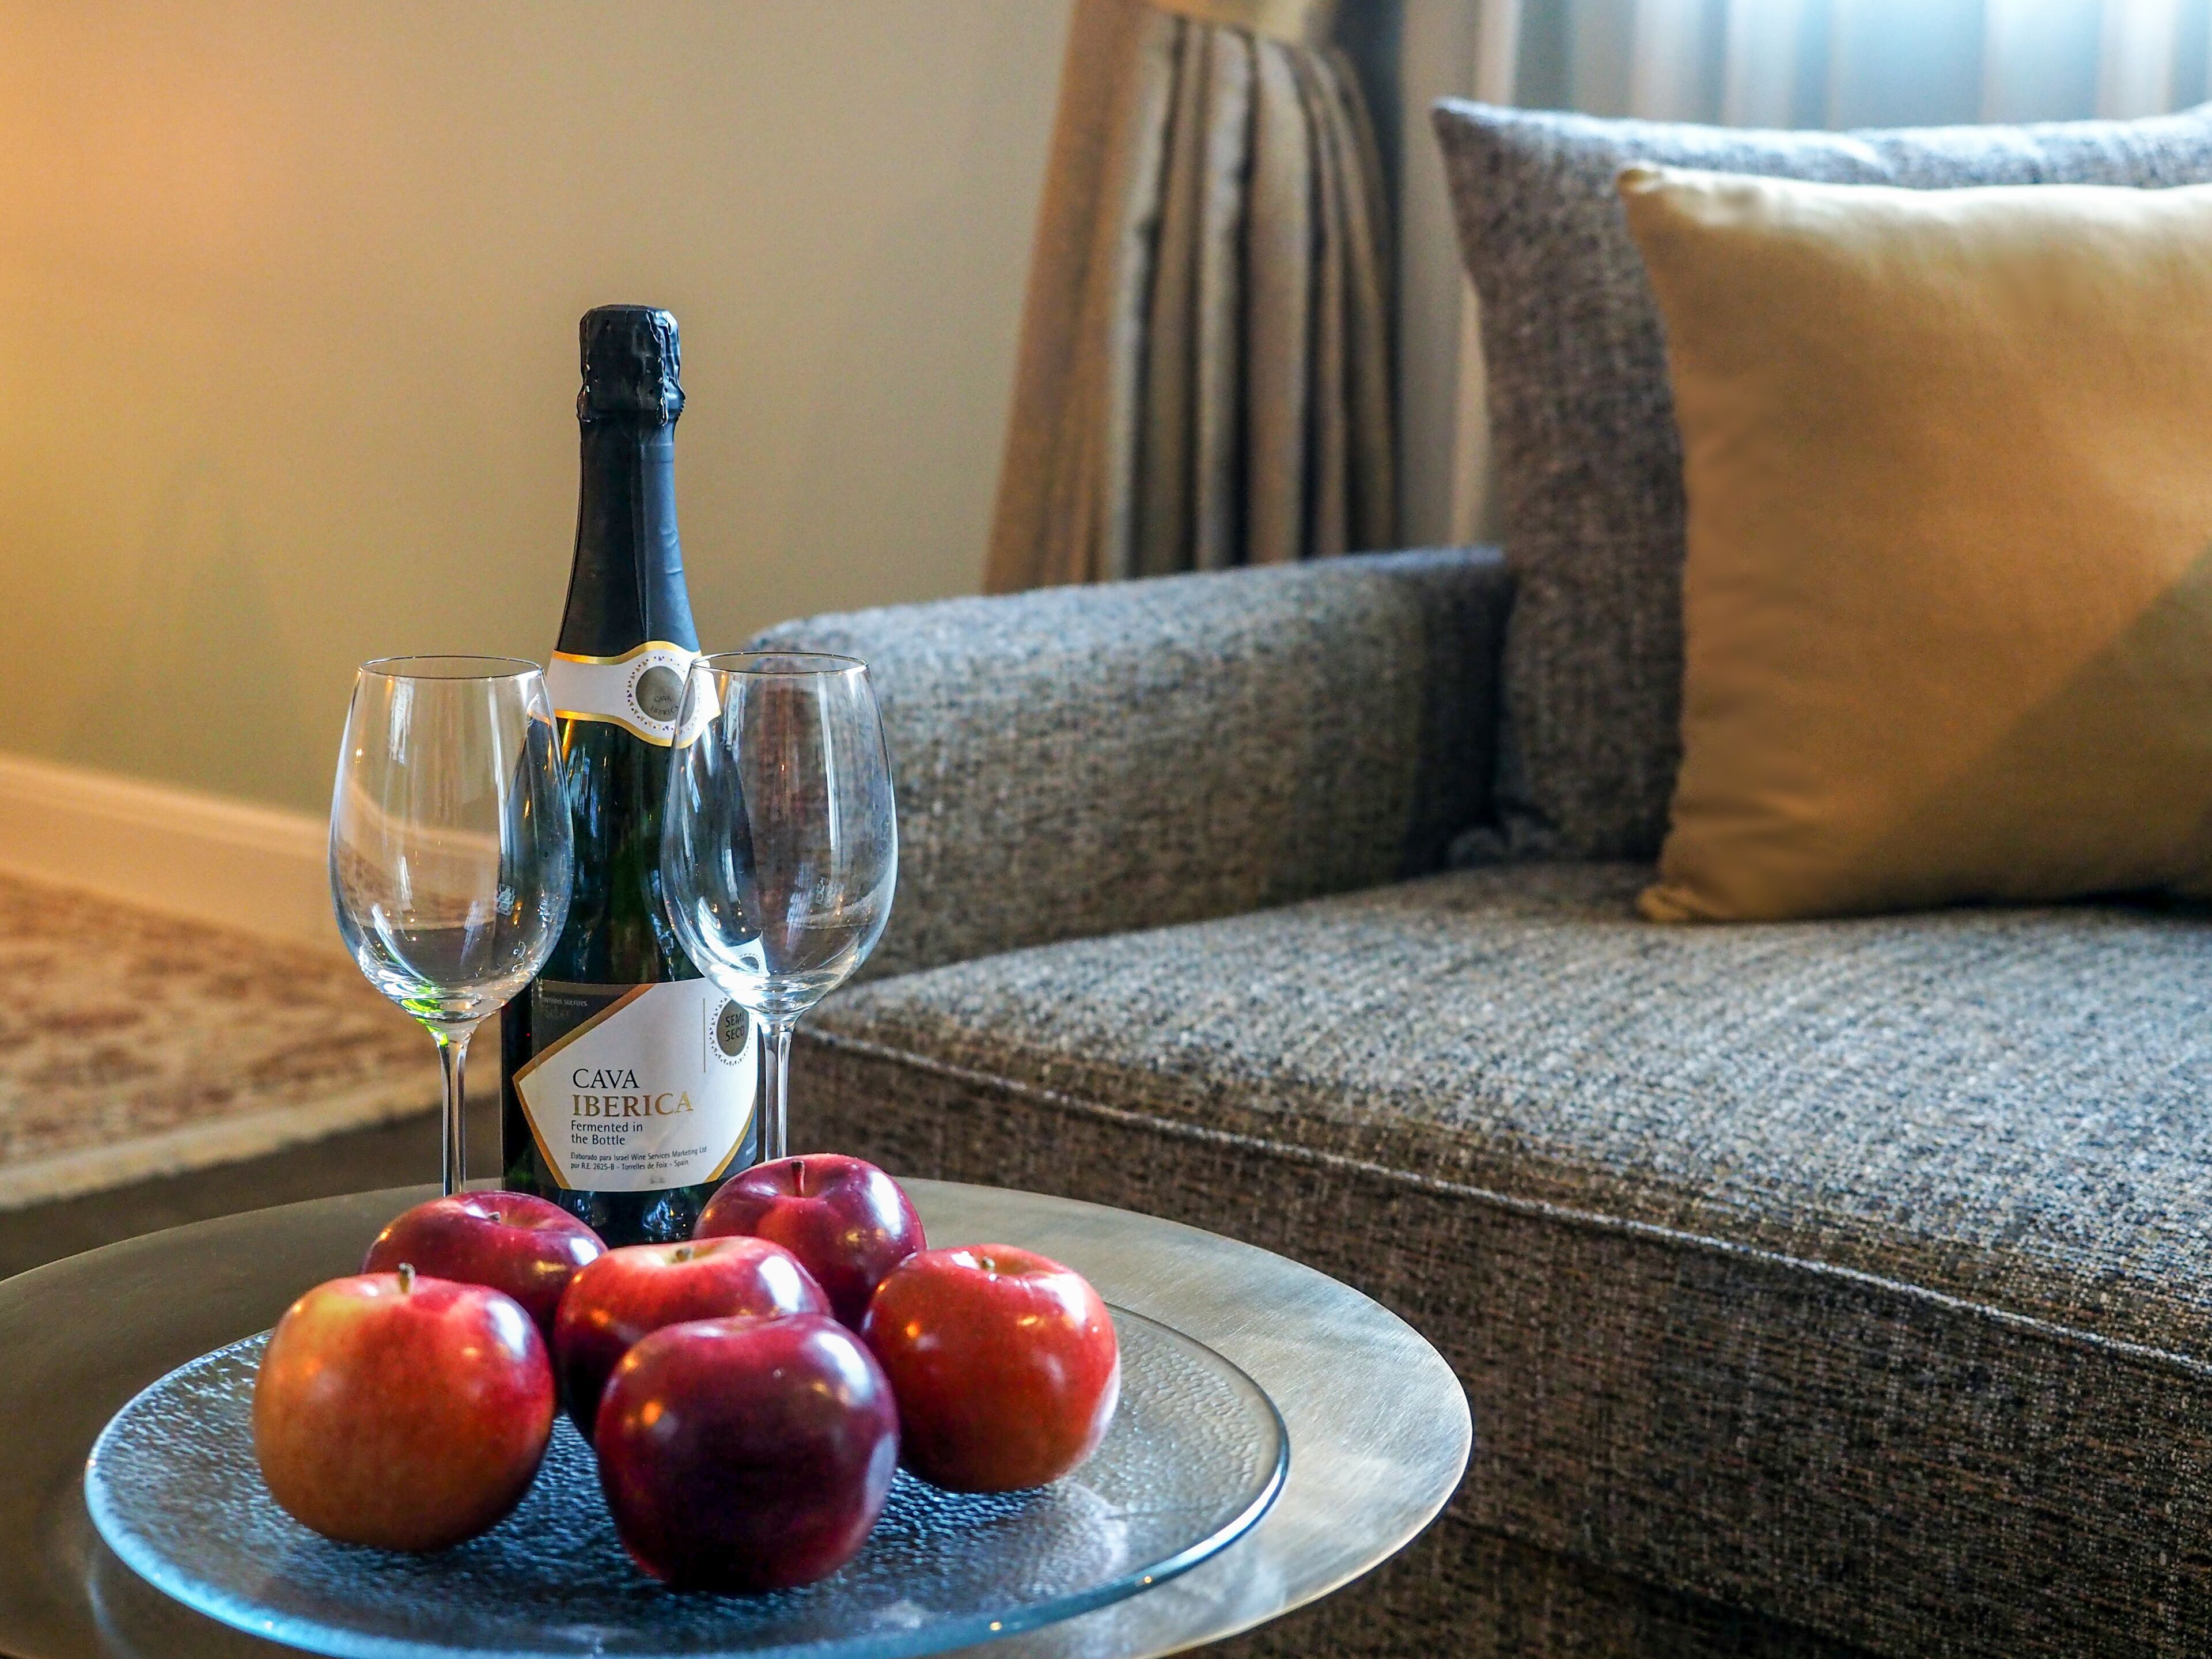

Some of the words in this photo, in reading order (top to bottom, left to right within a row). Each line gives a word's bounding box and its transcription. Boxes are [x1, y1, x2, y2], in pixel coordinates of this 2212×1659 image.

[725, 1012, 744, 1028] SEMI
[725, 1025, 744, 1041] SECO
[573, 1069, 639, 1089] CAVA
[572, 1091, 694, 1117] IBERICA
[571, 1120, 628, 1132] Fermented
[633, 1121, 643, 1131] in
[571, 1134, 588, 1145] the
[592, 1134, 626, 1145] Bottle
[571, 1152, 597, 1160] Elaborado
[631, 1152, 646, 1160] Wine
[672, 1148, 698, 1157] Marketing
[675, 1159, 688, 1167] Spain
